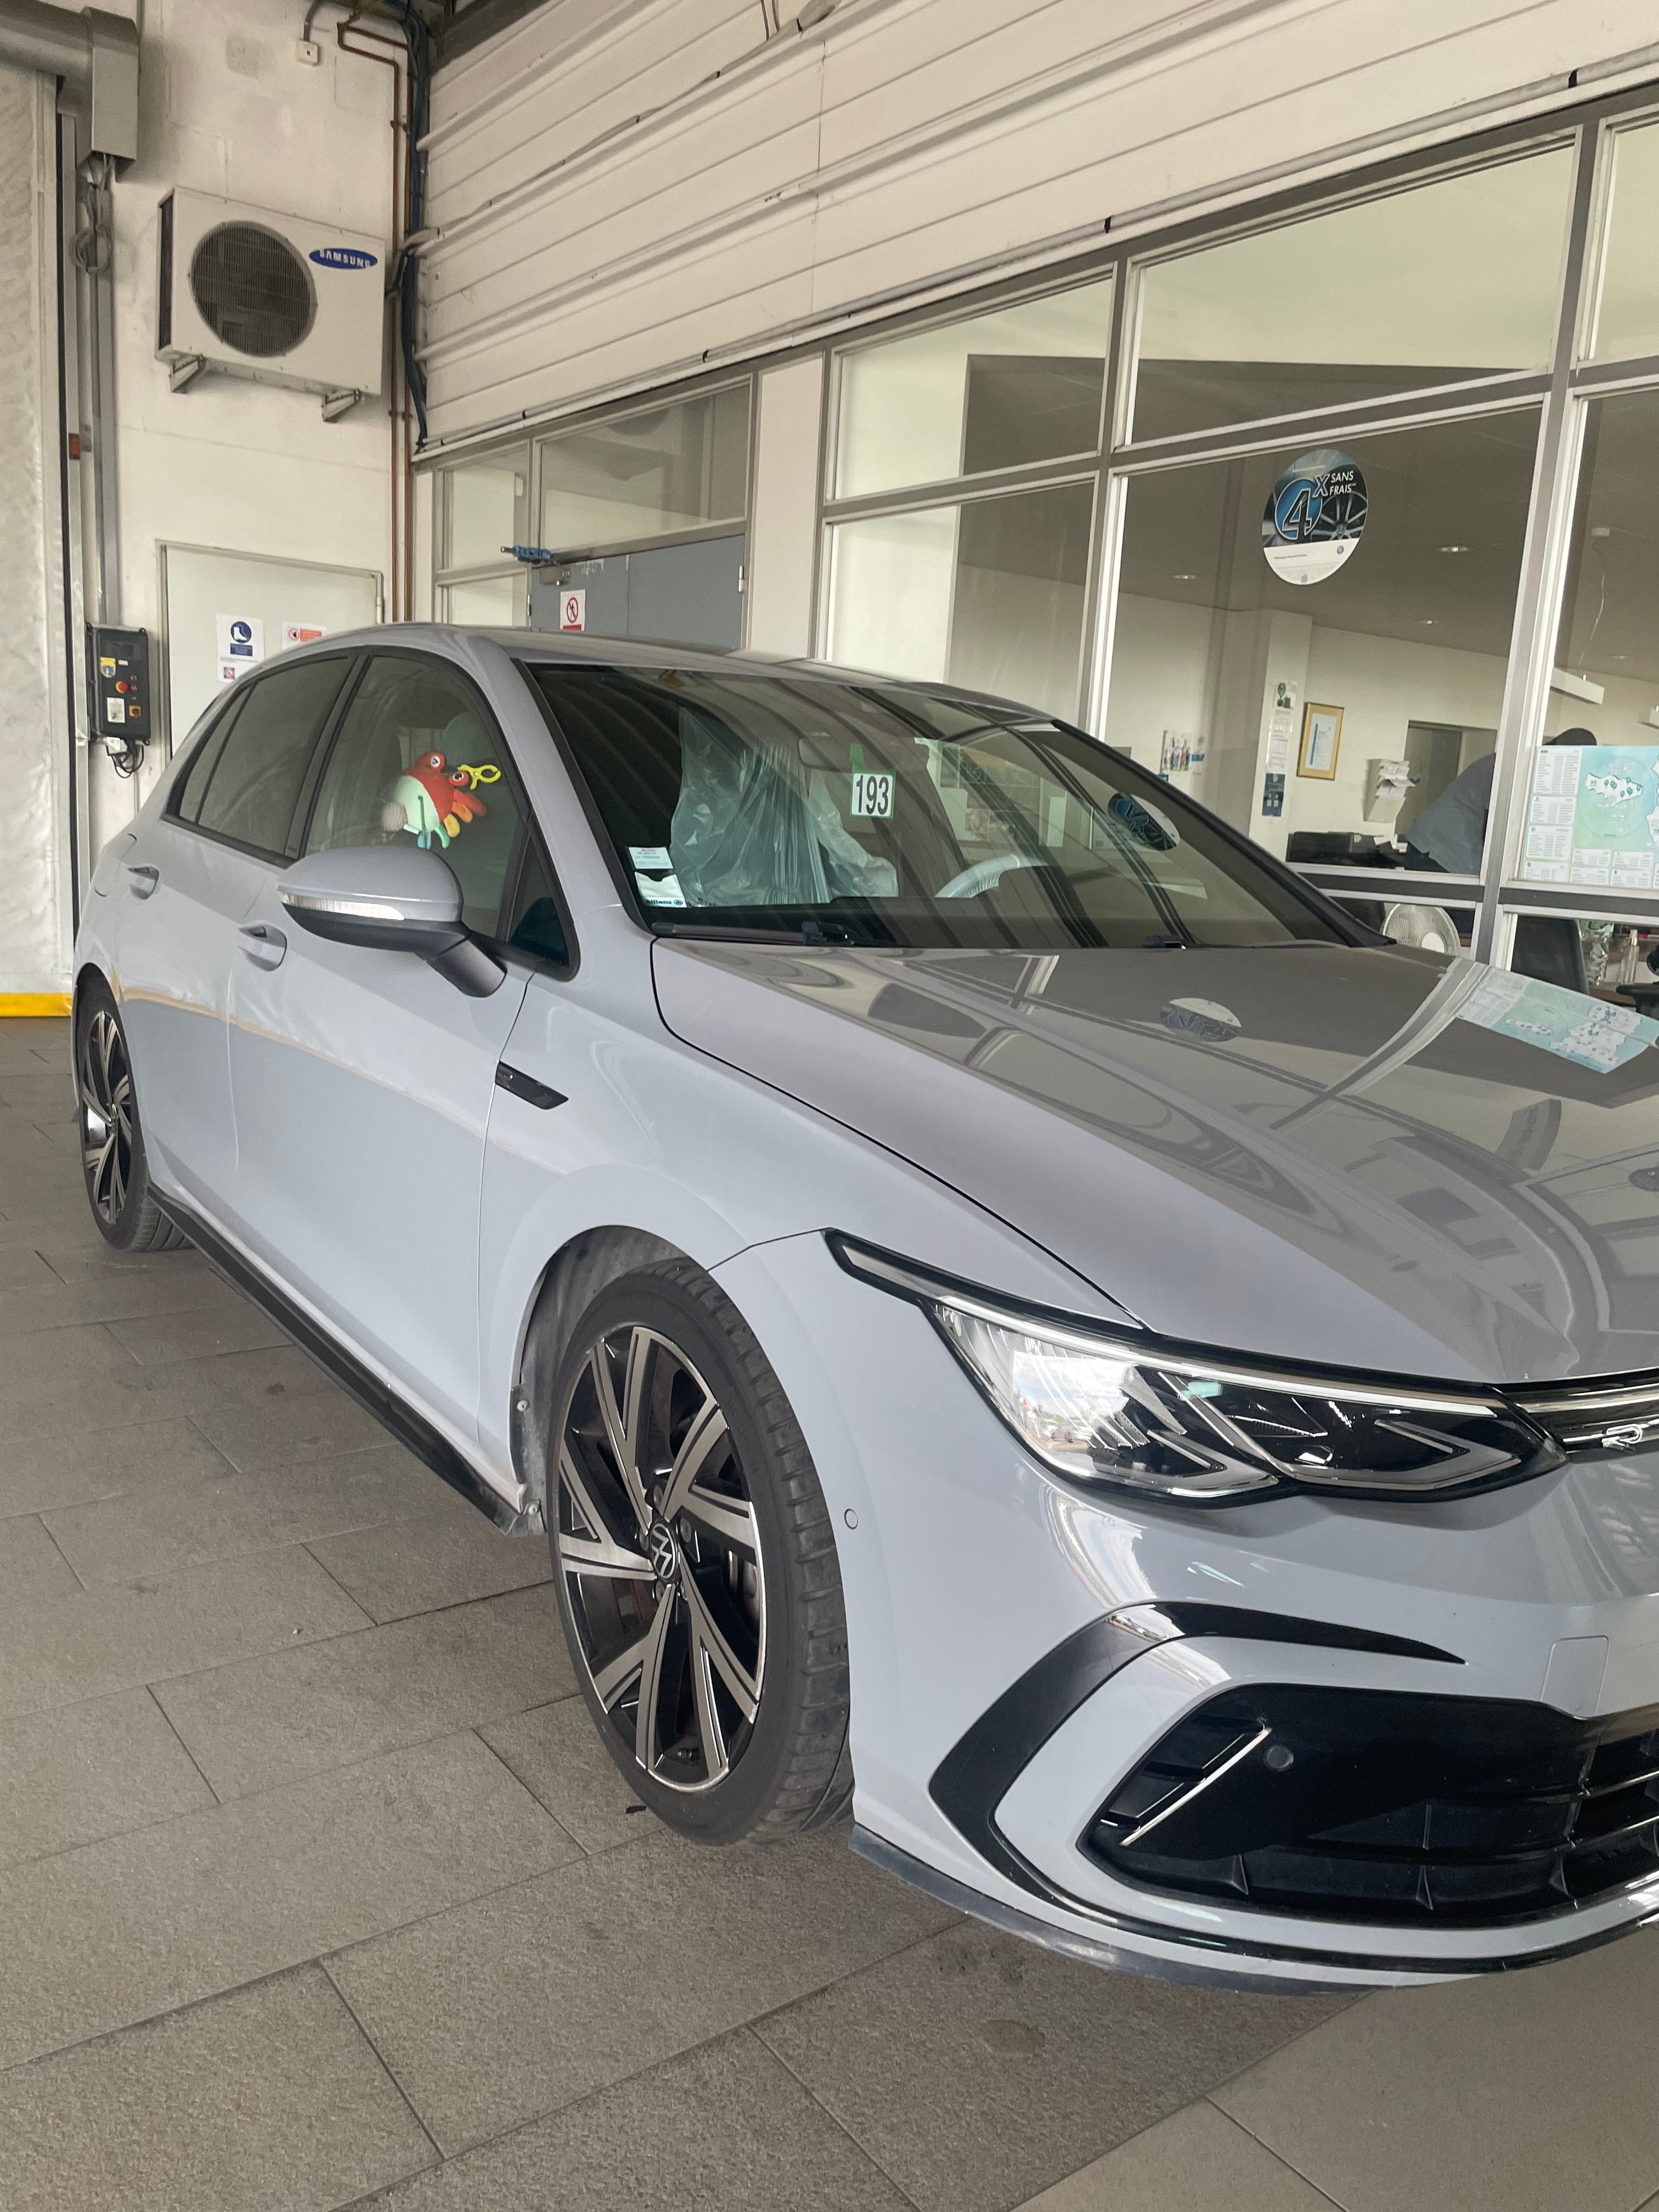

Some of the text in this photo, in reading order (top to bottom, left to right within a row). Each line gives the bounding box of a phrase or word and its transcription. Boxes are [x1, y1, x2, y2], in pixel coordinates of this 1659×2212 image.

[319, 249, 371, 269] SAMSUNG
[1330, 470, 1354, 483] SANS
[856, 775, 889, 815] 193
